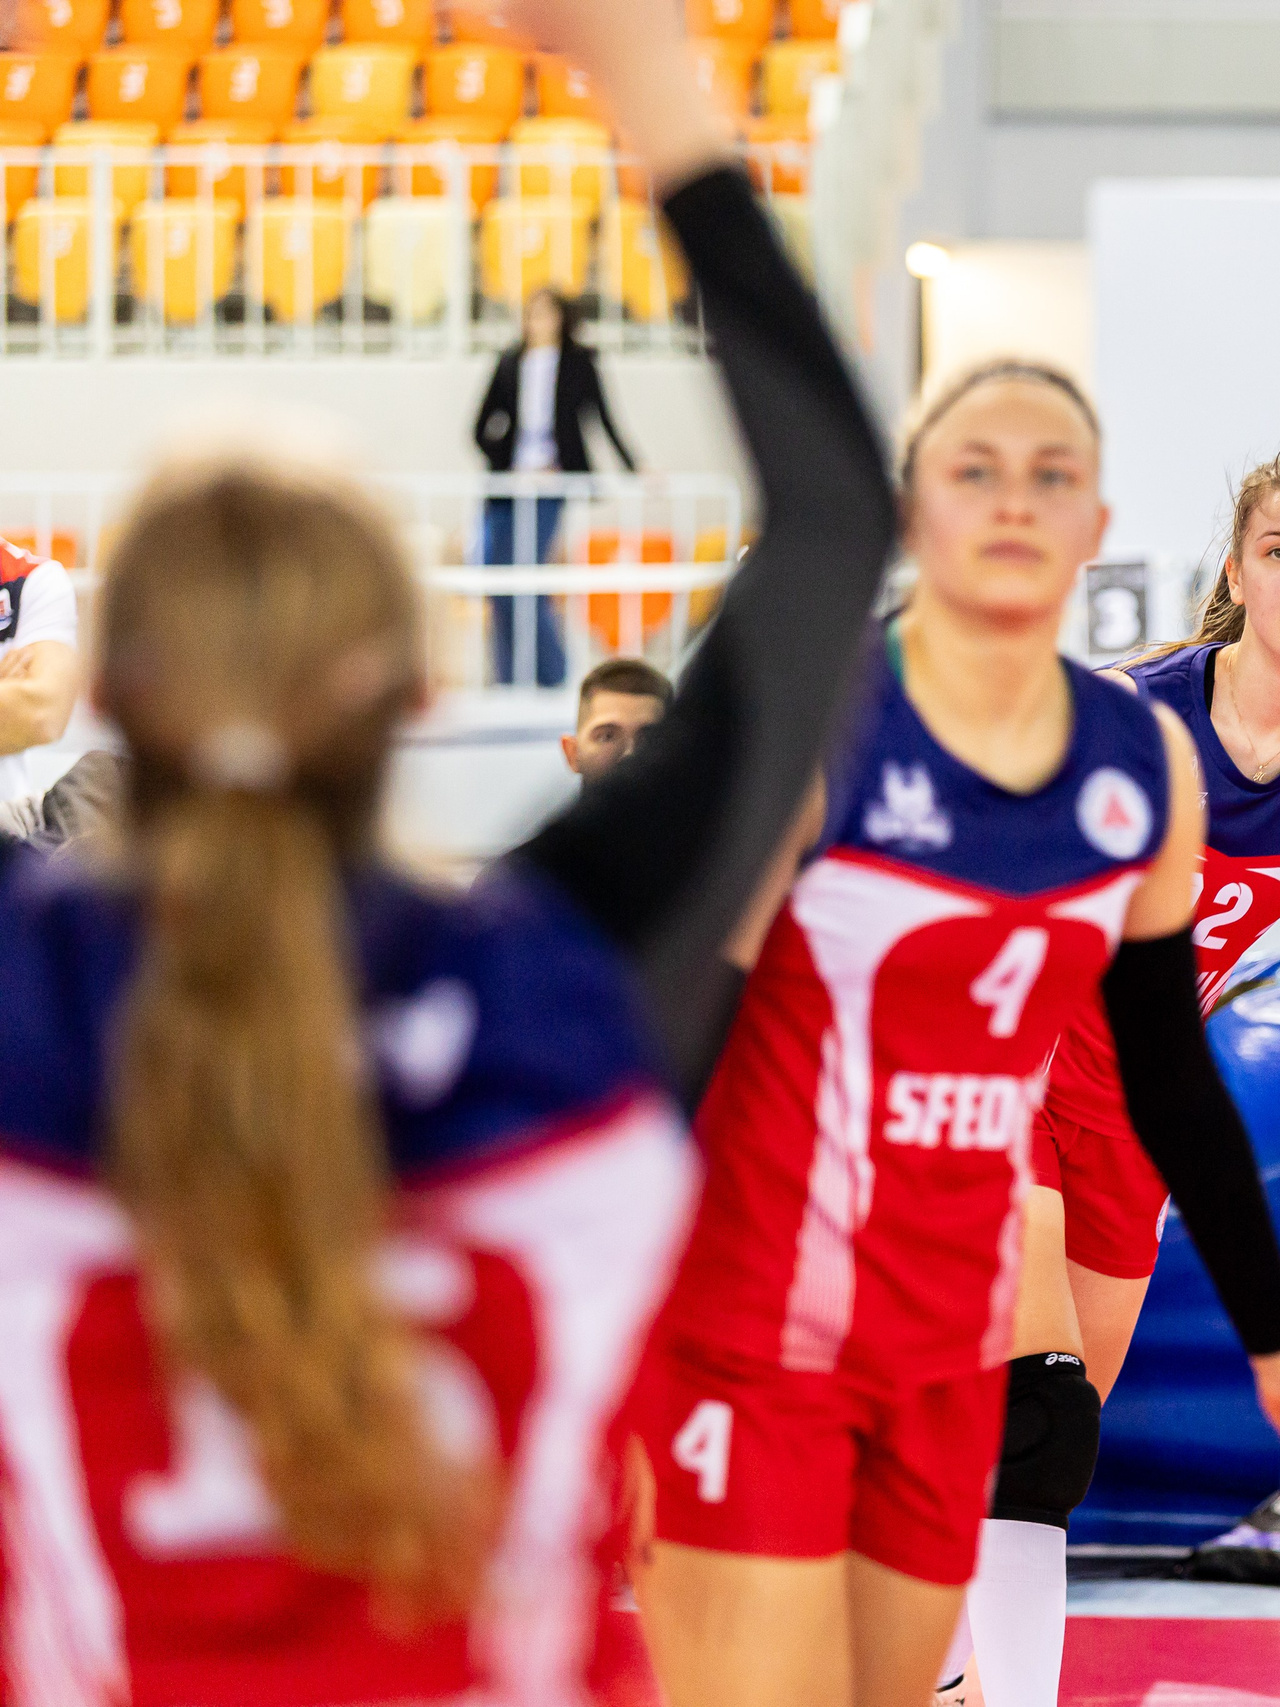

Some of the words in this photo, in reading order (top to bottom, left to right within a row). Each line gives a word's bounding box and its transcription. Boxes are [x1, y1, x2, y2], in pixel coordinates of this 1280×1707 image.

[1190, 872, 1254, 950] 2
[970, 927, 1050, 1038] 4
[671, 1399, 734, 1505] 4
